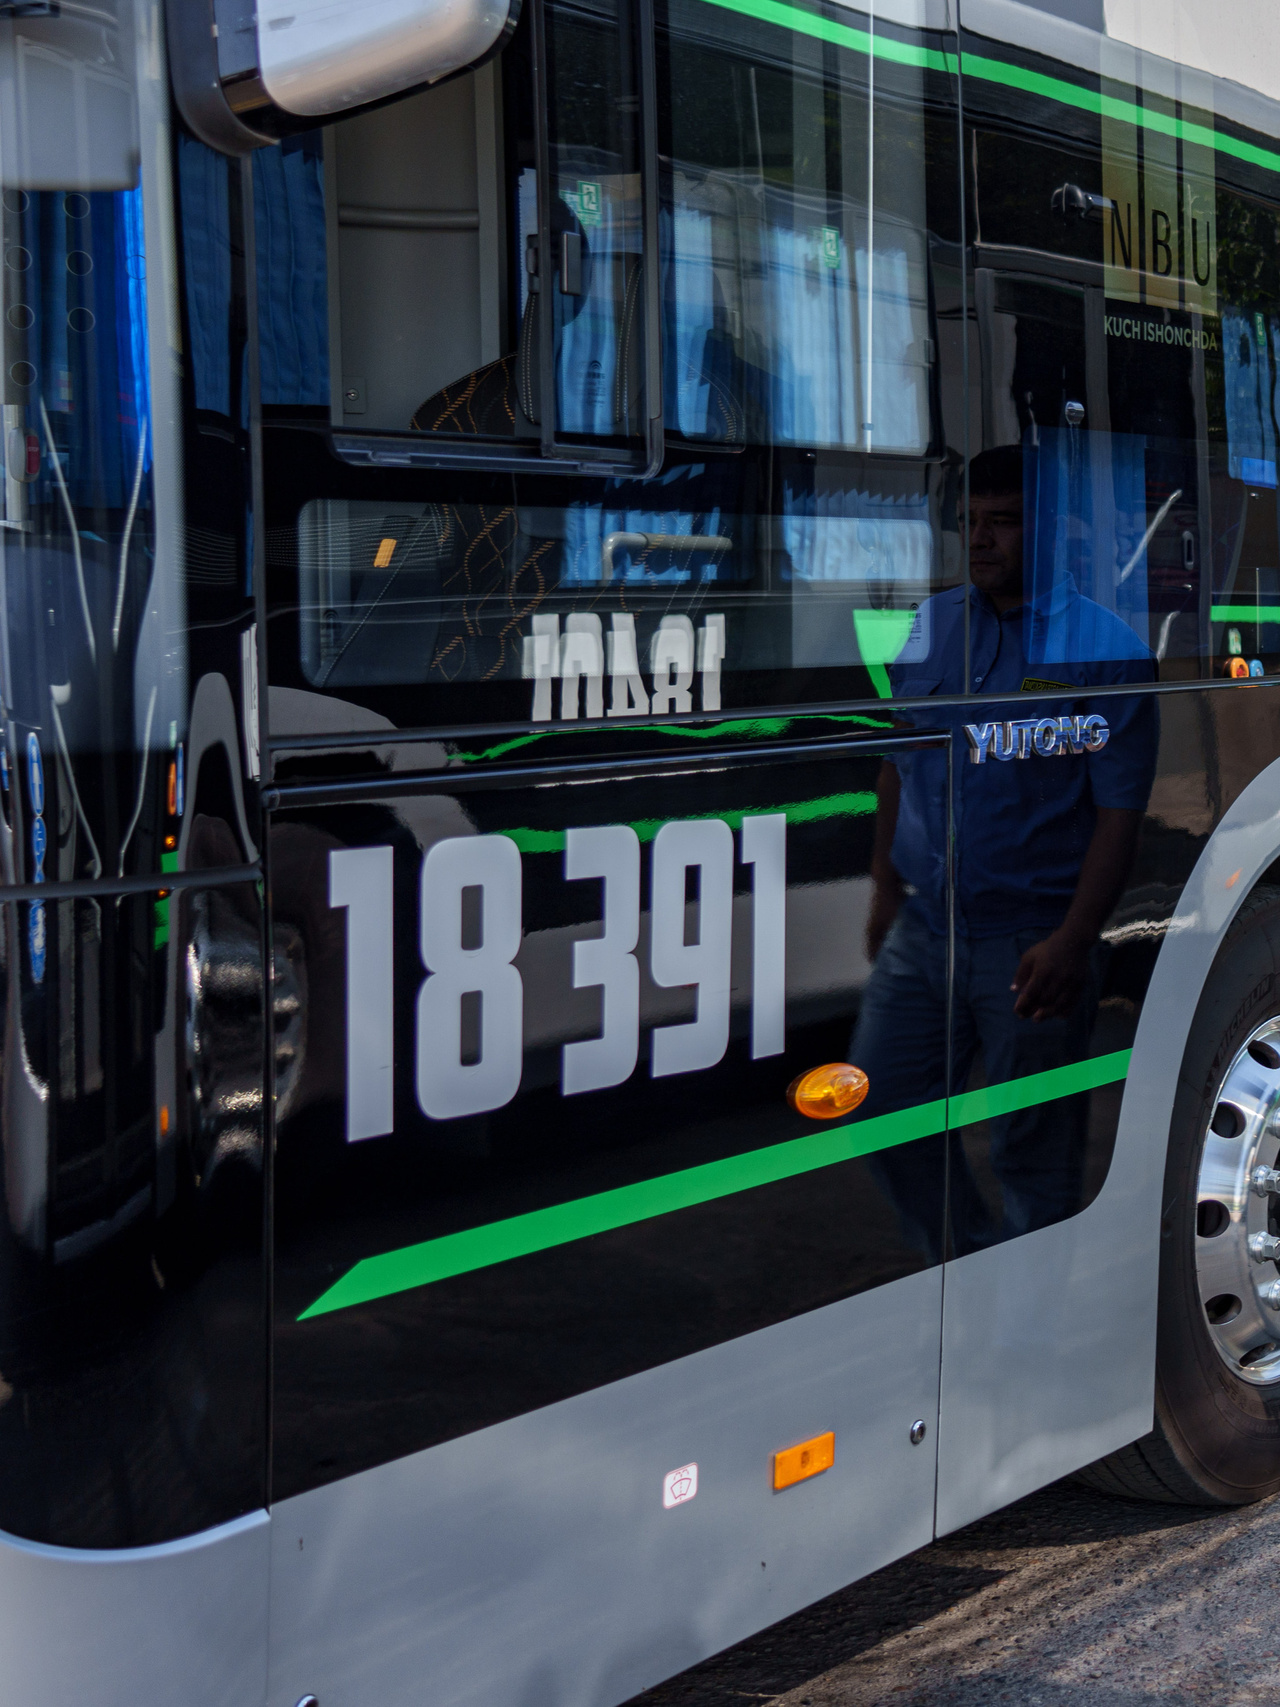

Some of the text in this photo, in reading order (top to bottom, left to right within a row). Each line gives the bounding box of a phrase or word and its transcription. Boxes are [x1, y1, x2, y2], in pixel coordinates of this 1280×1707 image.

[1111, 199, 1210, 286] NBU
[1104, 315, 1218, 351] KUCH ISHONCHDA
[961, 714, 1110, 764] YUTONG
